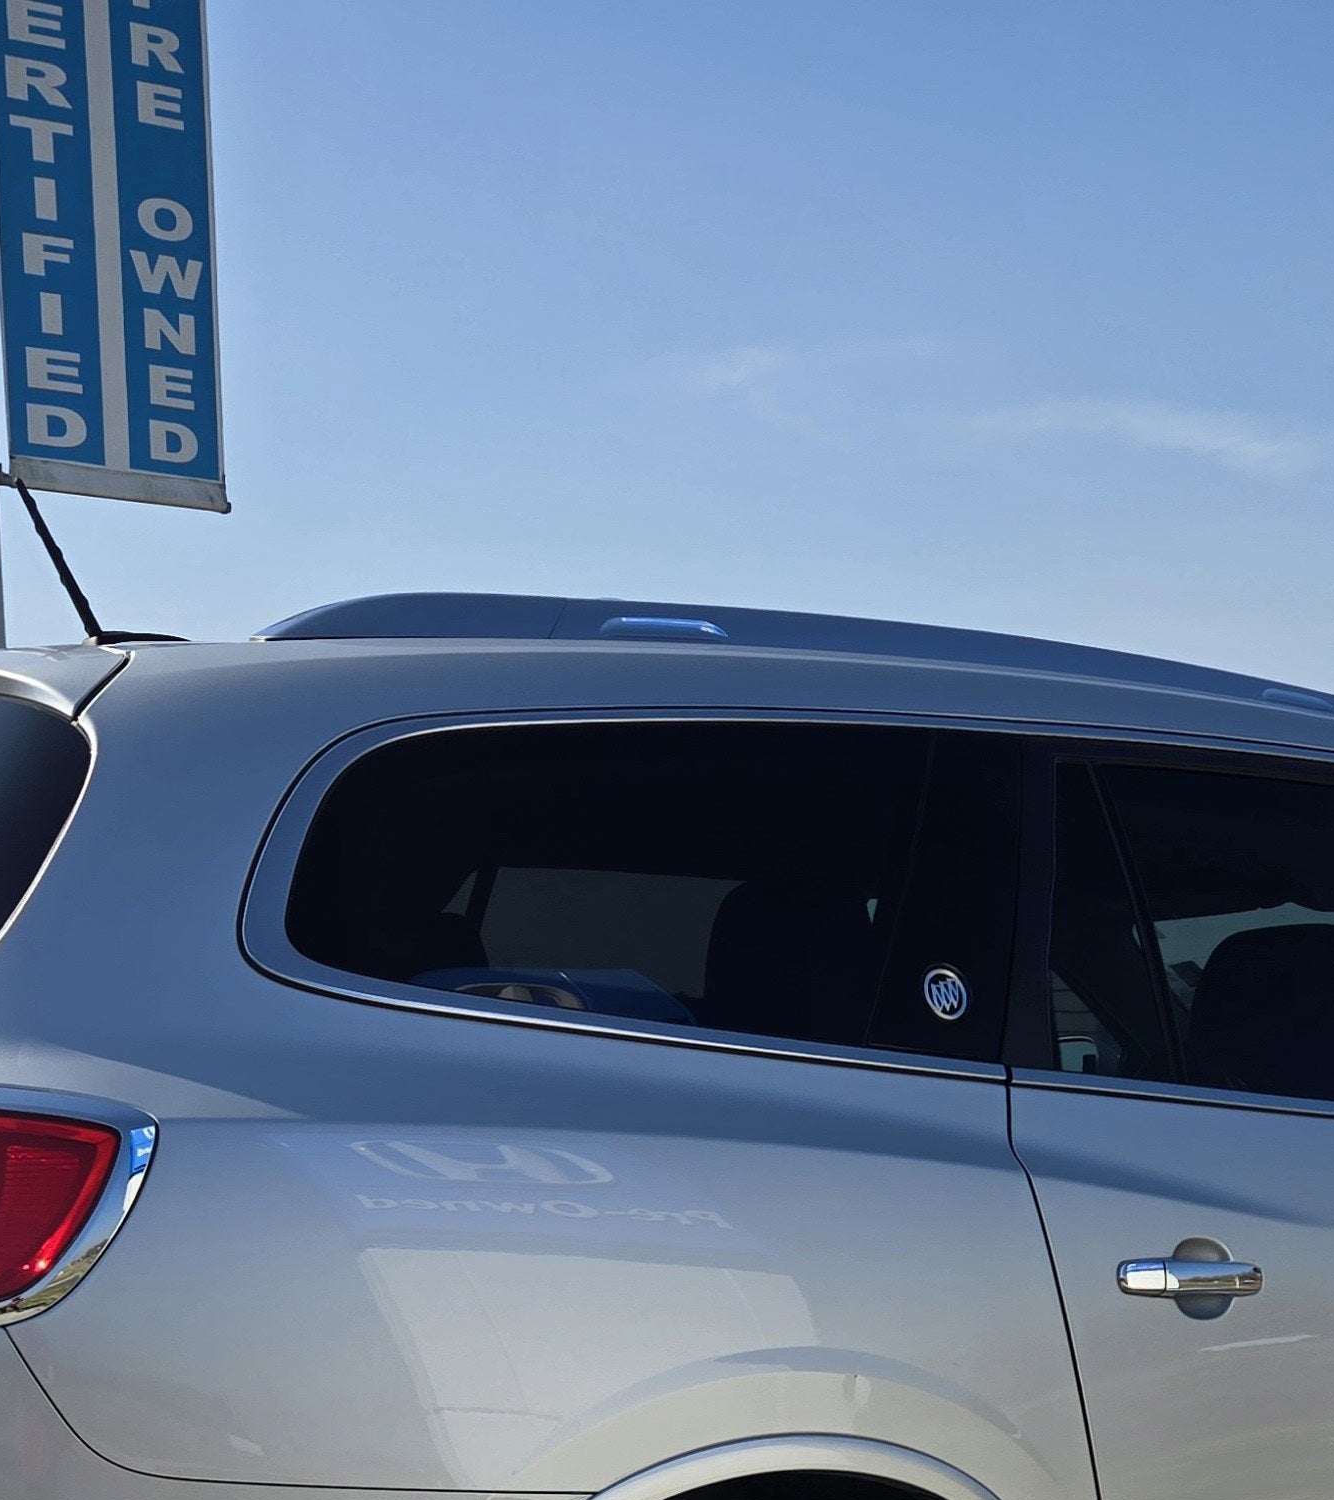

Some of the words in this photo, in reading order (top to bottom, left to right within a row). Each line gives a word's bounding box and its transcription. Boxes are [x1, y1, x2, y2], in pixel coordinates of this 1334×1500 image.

[129, 0, 185, 131] RE
[4, 0, 88, 449] ERTIFIED
[129, 197, 204, 465] OWNED
